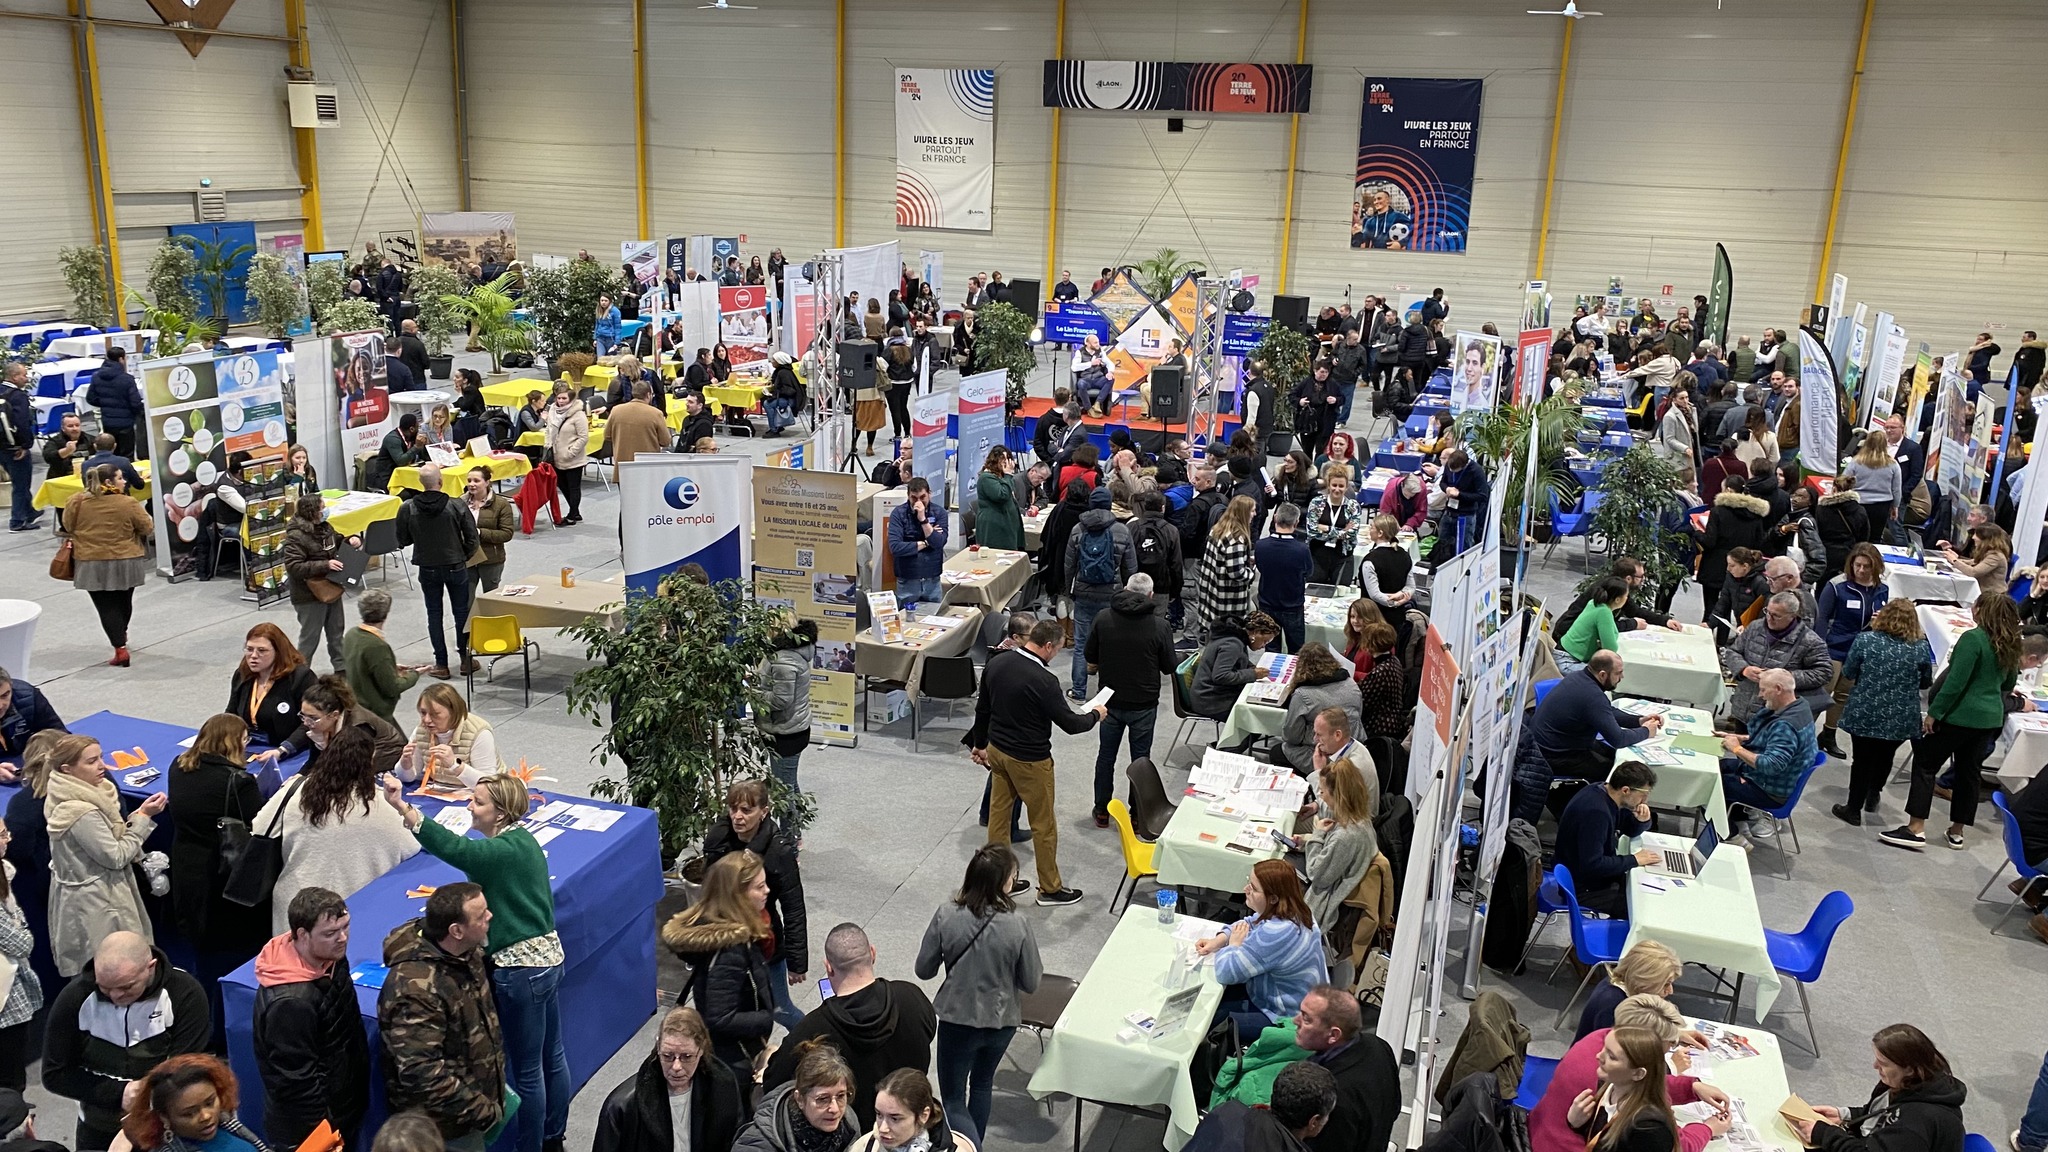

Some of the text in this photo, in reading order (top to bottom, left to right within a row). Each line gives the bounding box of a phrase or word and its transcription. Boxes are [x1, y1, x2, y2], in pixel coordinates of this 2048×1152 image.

[1232, 73, 1245, 81] 20
[1370, 84, 1384, 92] 20
[1244, 95, 1255, 104] 24
[1404, 120, 1471, 130] VIVRE LES JEUX
[1430, 130, 1470, 139] PARTOUT
[914, 136, 937, 144] VIVRE
[955, 137, 974, 145] JEUX
[1433, 140, 1469, 149] FRANCE
[926, 145, 962, 154] PARTOUT
[934, 154, 966, 164] FRANCE
[1810, 382, 1820, 458] La performance
[359, 429, 378, 440] DAUNAT
[772, 487, 790, 495] Réseau
[801, 489, 824, 499] Missions
[825, 492, 844, 500] Locales
[648, 513, 714, 528] pôle emploi
[773, 517, 797, 525] MISSION
[798, 520, 820, 528] LOCALE
[831, 522, 847, 530] LAON
